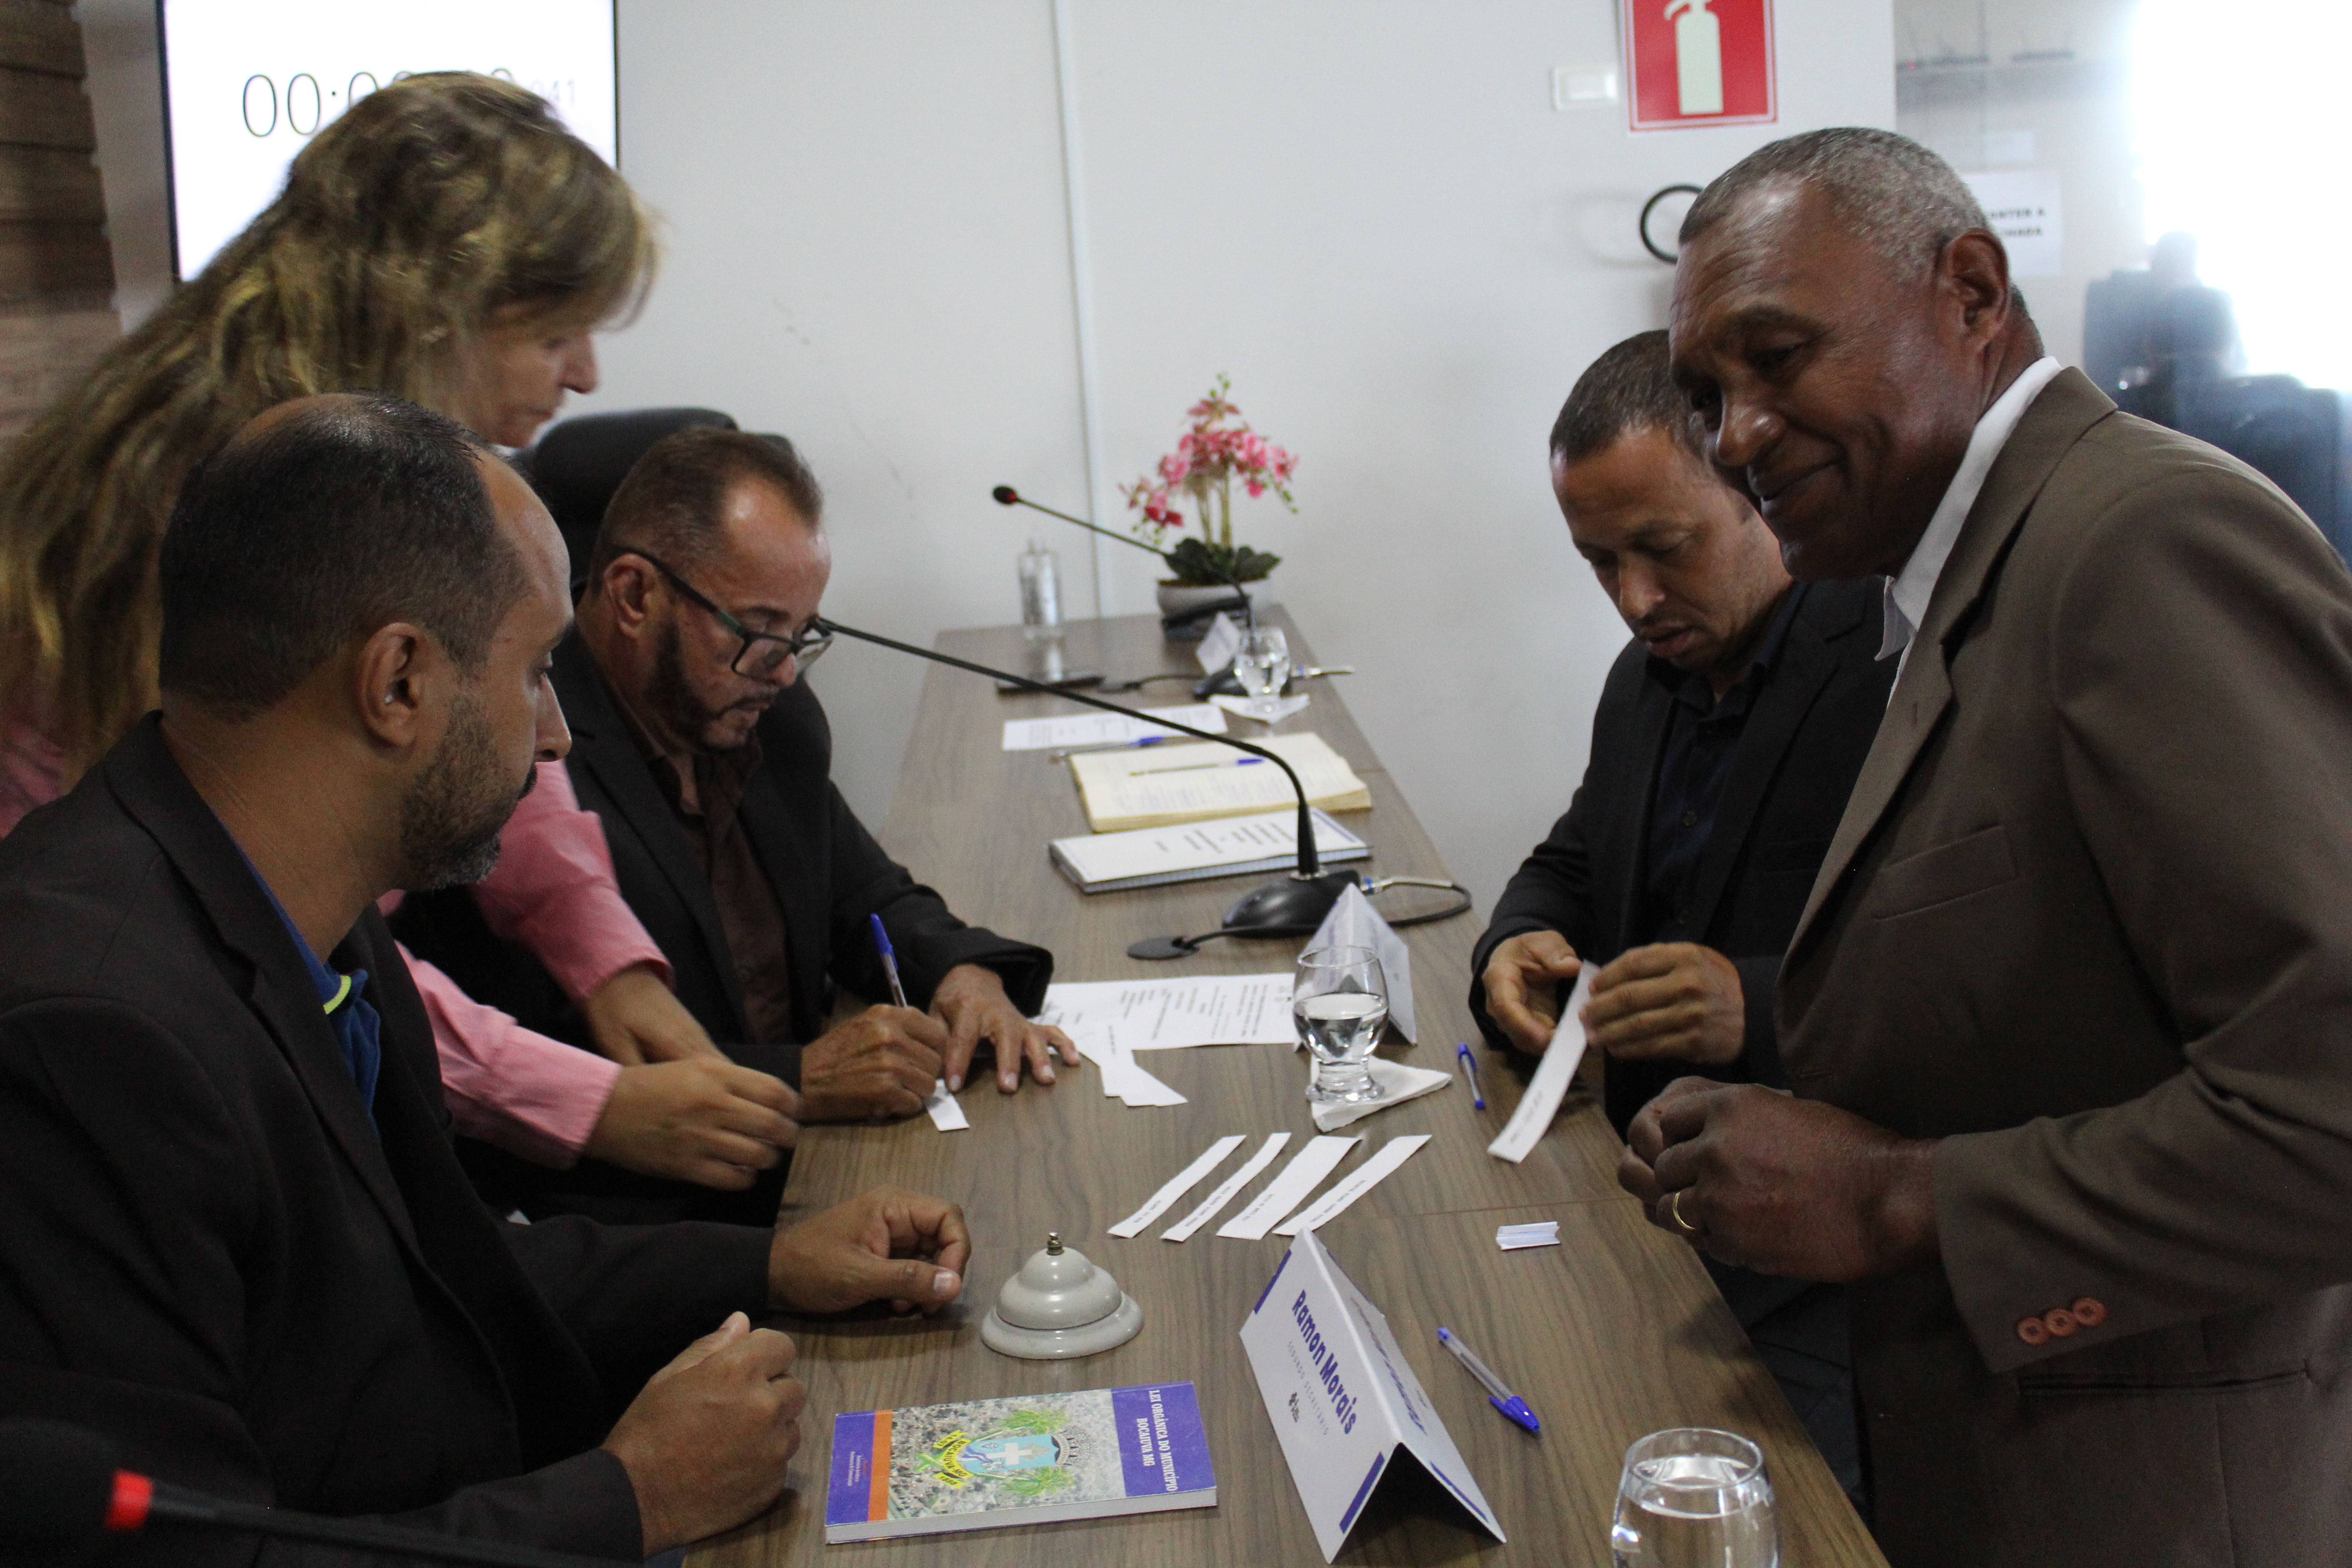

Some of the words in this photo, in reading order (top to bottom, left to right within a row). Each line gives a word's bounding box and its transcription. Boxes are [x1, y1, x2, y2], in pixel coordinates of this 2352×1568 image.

[1292, 1289, 1326, 1366] Ramon
[1319, 1352, 1357, 1435] Morais
[1148, 1390, 1162, 1402] LEI
[1136, 1417, 1153, 1453] BOCAIUVA
[1151, 1403, 1169, 1440] ORGÂNICA
[1142, 1453, 1156, 1467] MG
[1157, 1440, 1171, 1451] DO
[1160, 1452, 1180, 1492] MUNICÍPIO
